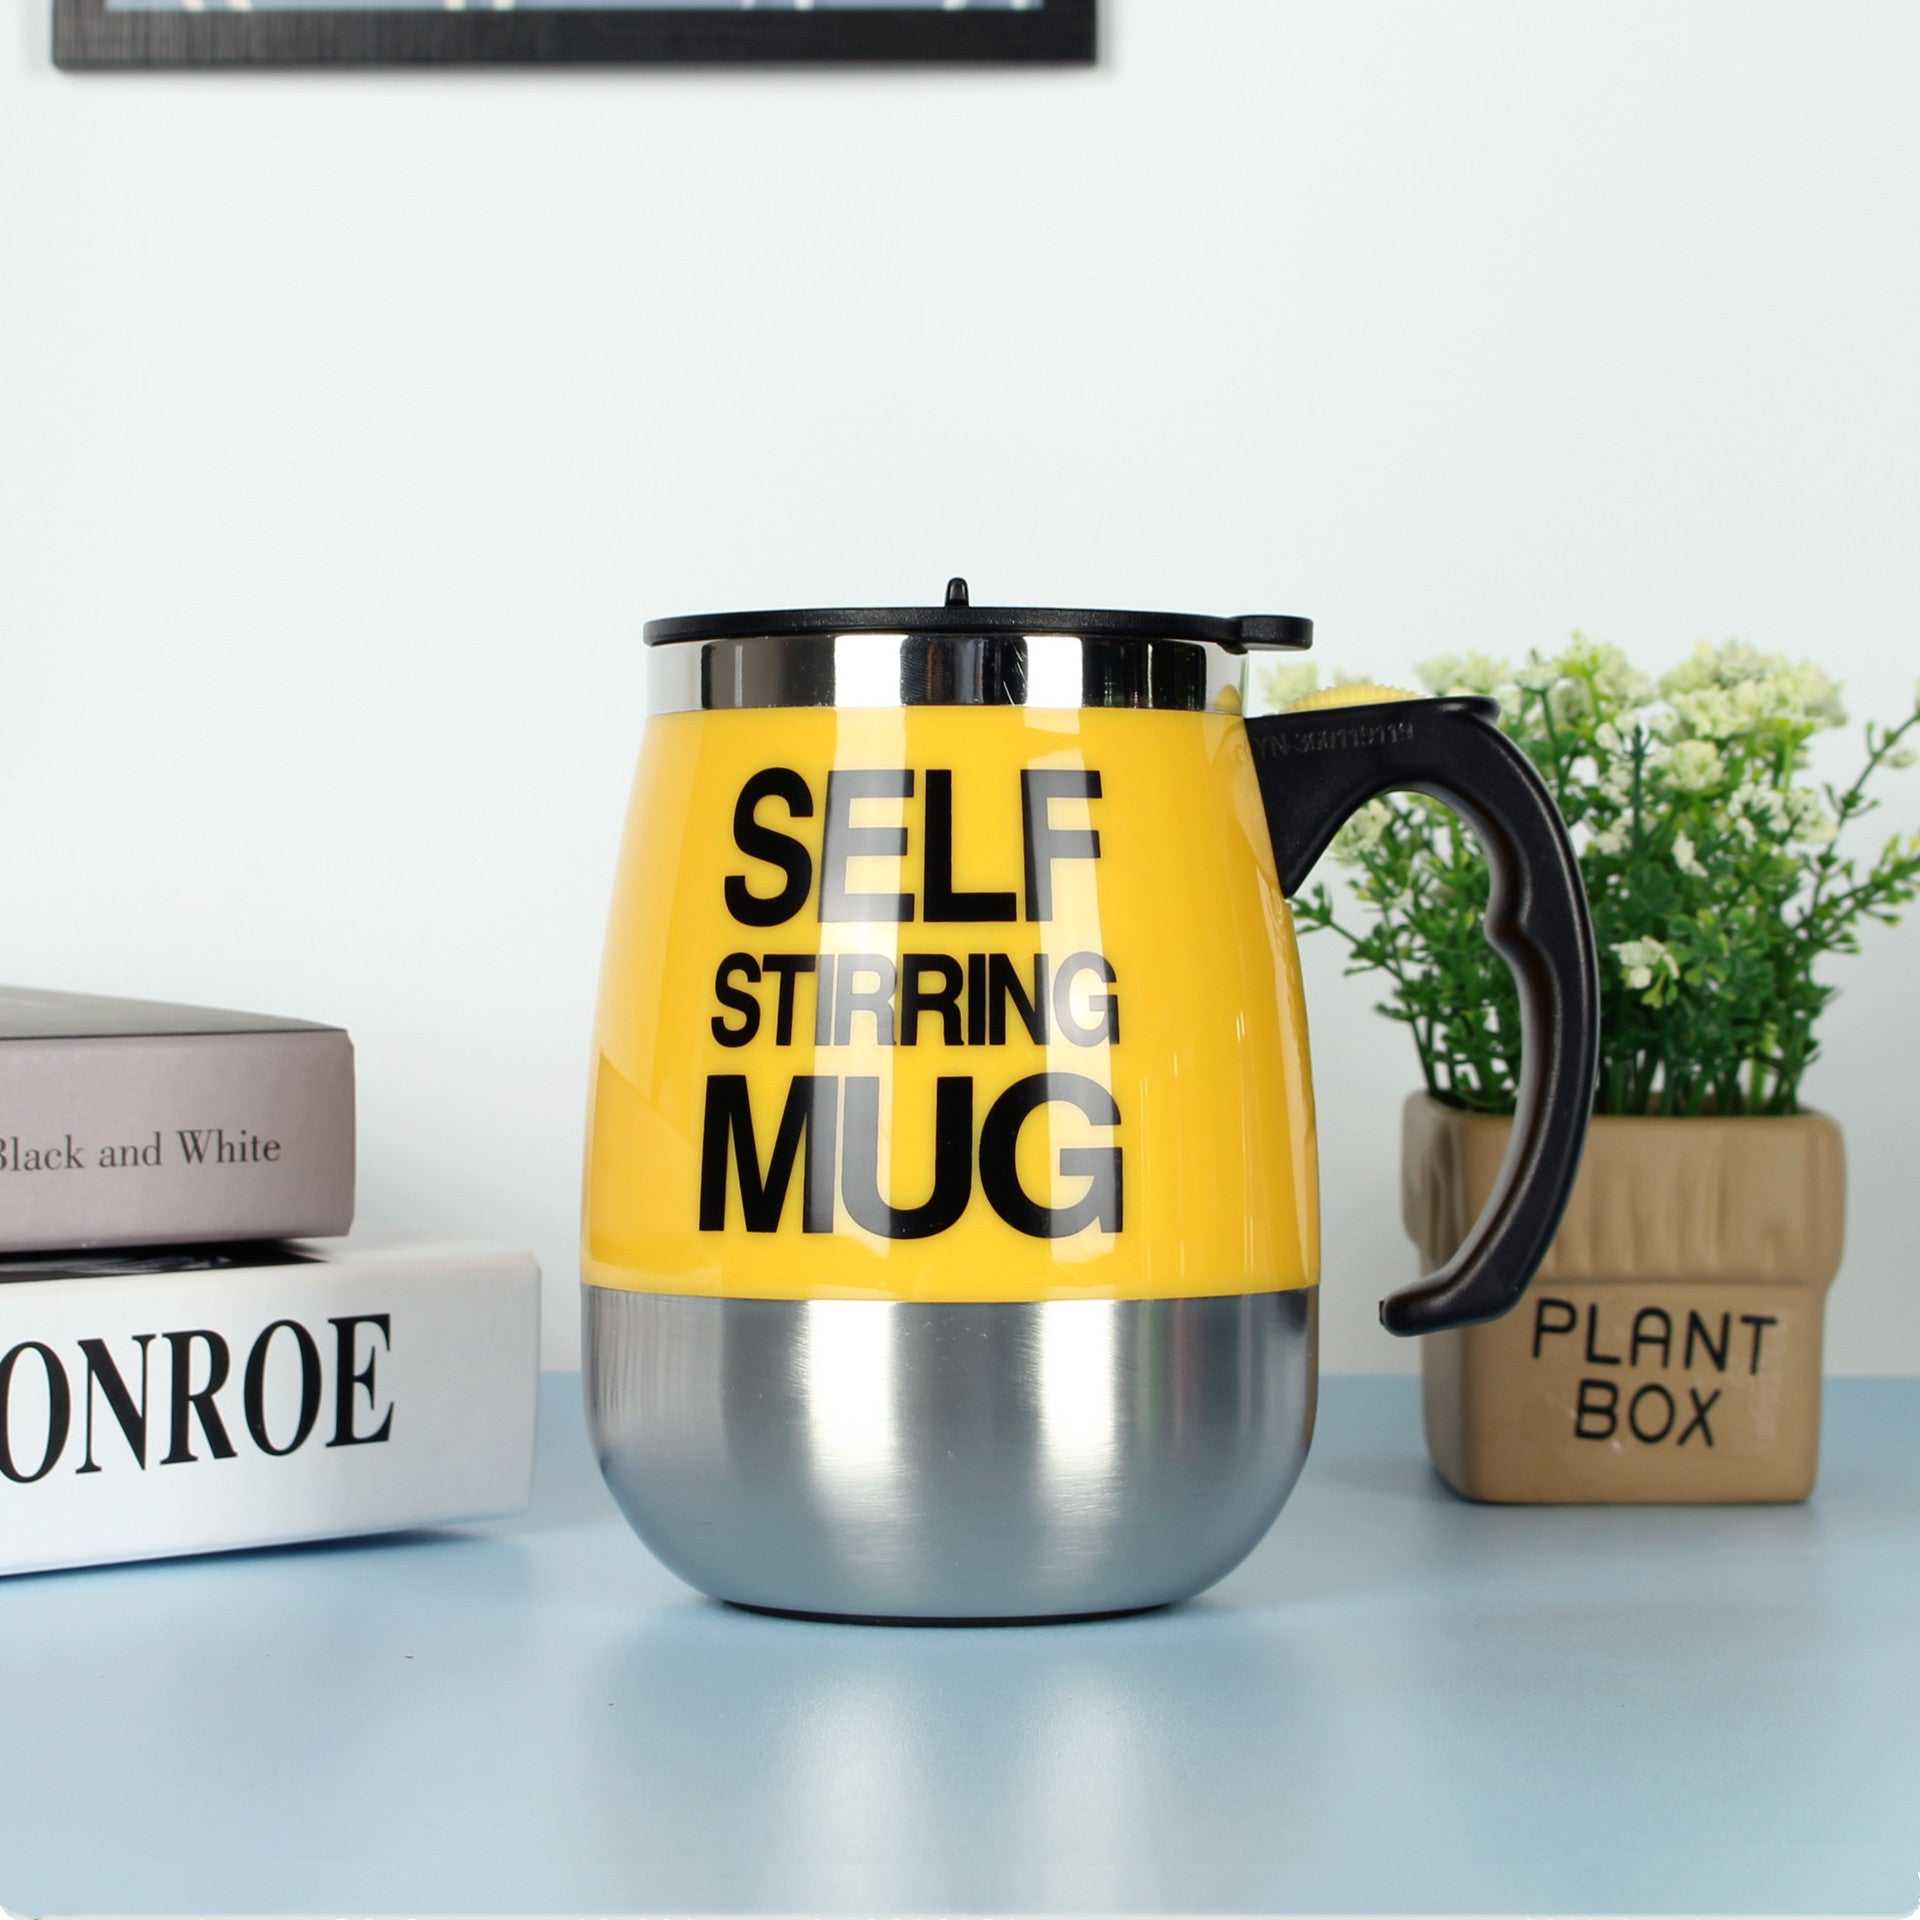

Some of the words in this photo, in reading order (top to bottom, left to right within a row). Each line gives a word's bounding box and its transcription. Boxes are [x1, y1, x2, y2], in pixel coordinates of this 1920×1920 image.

[724, 766, 1103, 928] SELF
[710, 951, 1121, 1048] STIRRING
[99, 1131, 162, 1169] and
[177, 1129, 282, 1165] White
[698, 1071, 1124, 1240] MUG
[1532, 1297, 1778, 1376] PLANT
[1573, 1377, 1722, 1448] BOX
